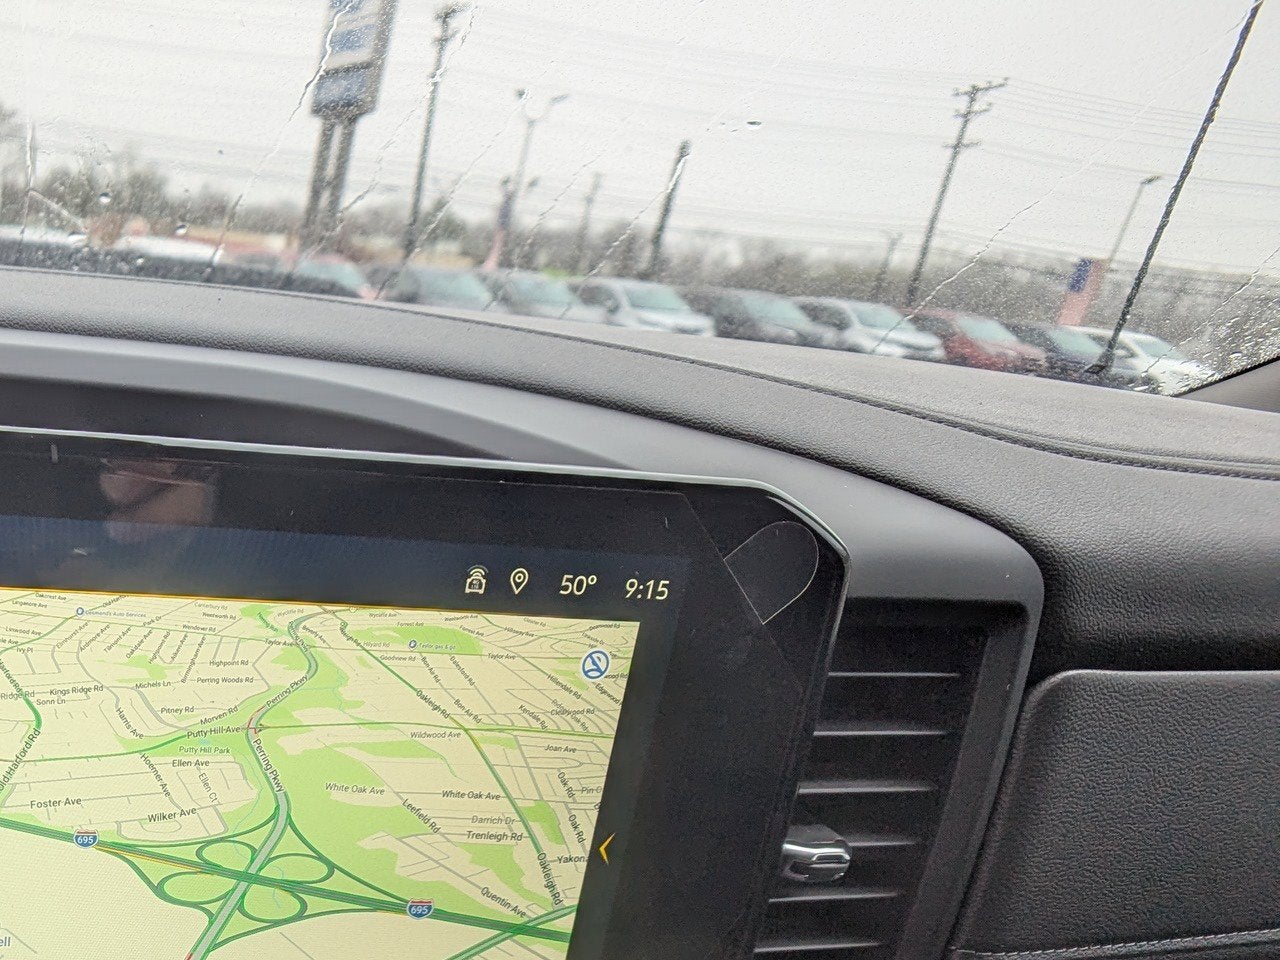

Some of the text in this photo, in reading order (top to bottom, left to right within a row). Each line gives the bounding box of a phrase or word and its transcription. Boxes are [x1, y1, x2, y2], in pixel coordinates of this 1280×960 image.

[559, 574, 598, 595] 50°
[624, 578, 670, 600] 9:15
[50, 684, 104, 697] Kings Ridge Rd
[160, 706, 184, 715] Pitney
[186, 725, 241, 739] Putty Hill Ave
[410, 731, 461, 739] Wildwood Ave
[6, 741, 32, 778] Harford
[28, 728, 41, 744] Rd
[172, 759, 210, 768] Ellen Ave
[252, 739, 285, 793] Perring Pkwy
[325, 782, 385, 796] White Oak Ave
[442, 790, 501, 801] White Oak Ave
[30, 797, 82, 809] Foster Ave
[148, 807, 197, 823] Wilker Ave
[402, 798, 441, 834] Leefield Rd
[471, 815, 516, 825] Darrich Dr
[568, 814, 586, 844] Oak Rd
[77, 836, 94, 845] 695
[467, 831, 523, 842] Trenleigh Rd
[537, 852, 563, 906] Oakleigh Rd
[480, 886, 527, 918] Quentin Ave
[410, 904, 429, 915] 695
